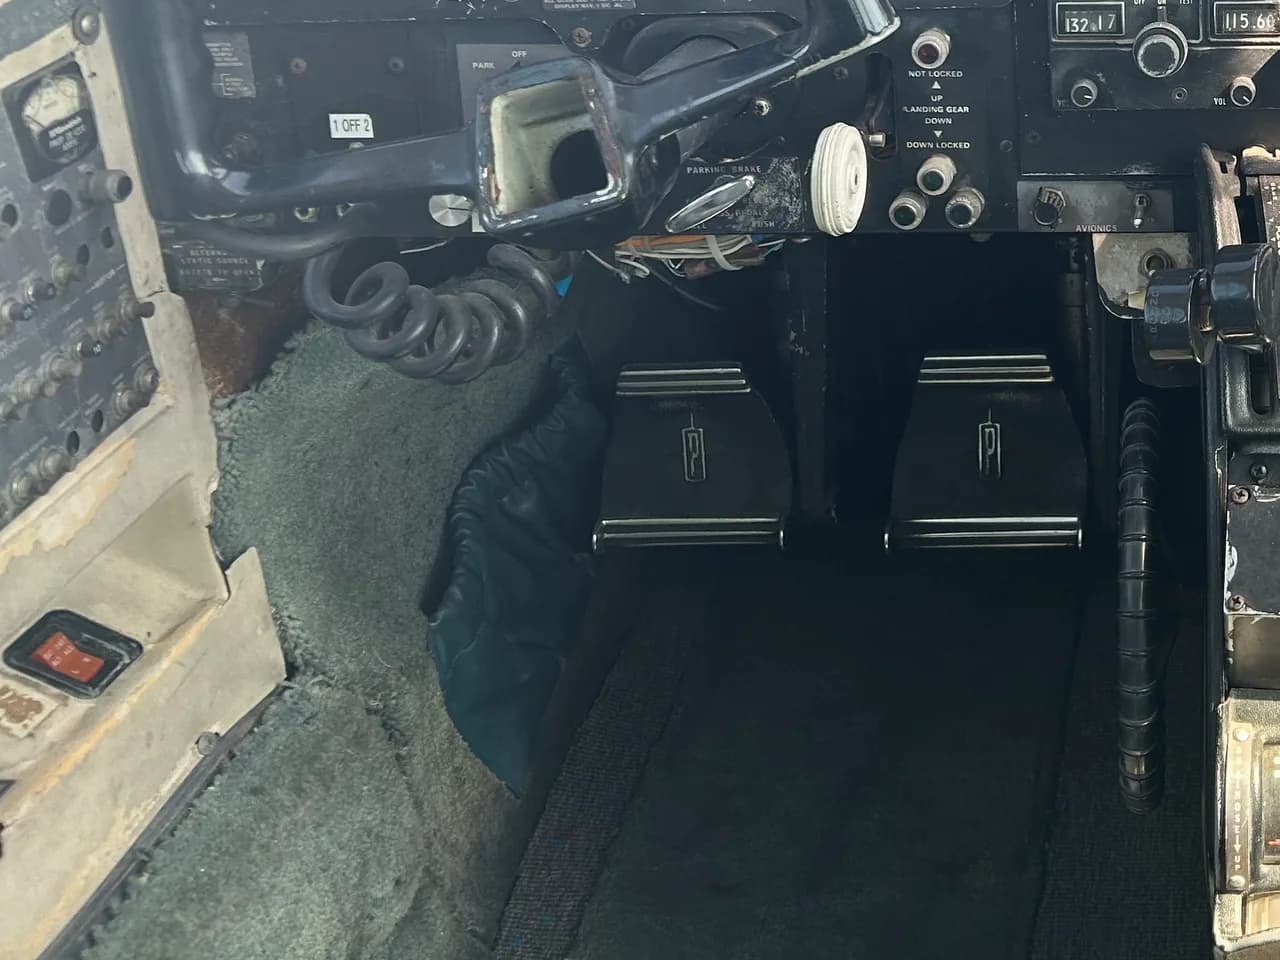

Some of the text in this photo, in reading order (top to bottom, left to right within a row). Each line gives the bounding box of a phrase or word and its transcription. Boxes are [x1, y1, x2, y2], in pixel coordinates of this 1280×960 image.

[343, 119, 360, 132] OFF
[687, 166, 727, 174] PARKING
[1235, 856, 1241, 871] UP
